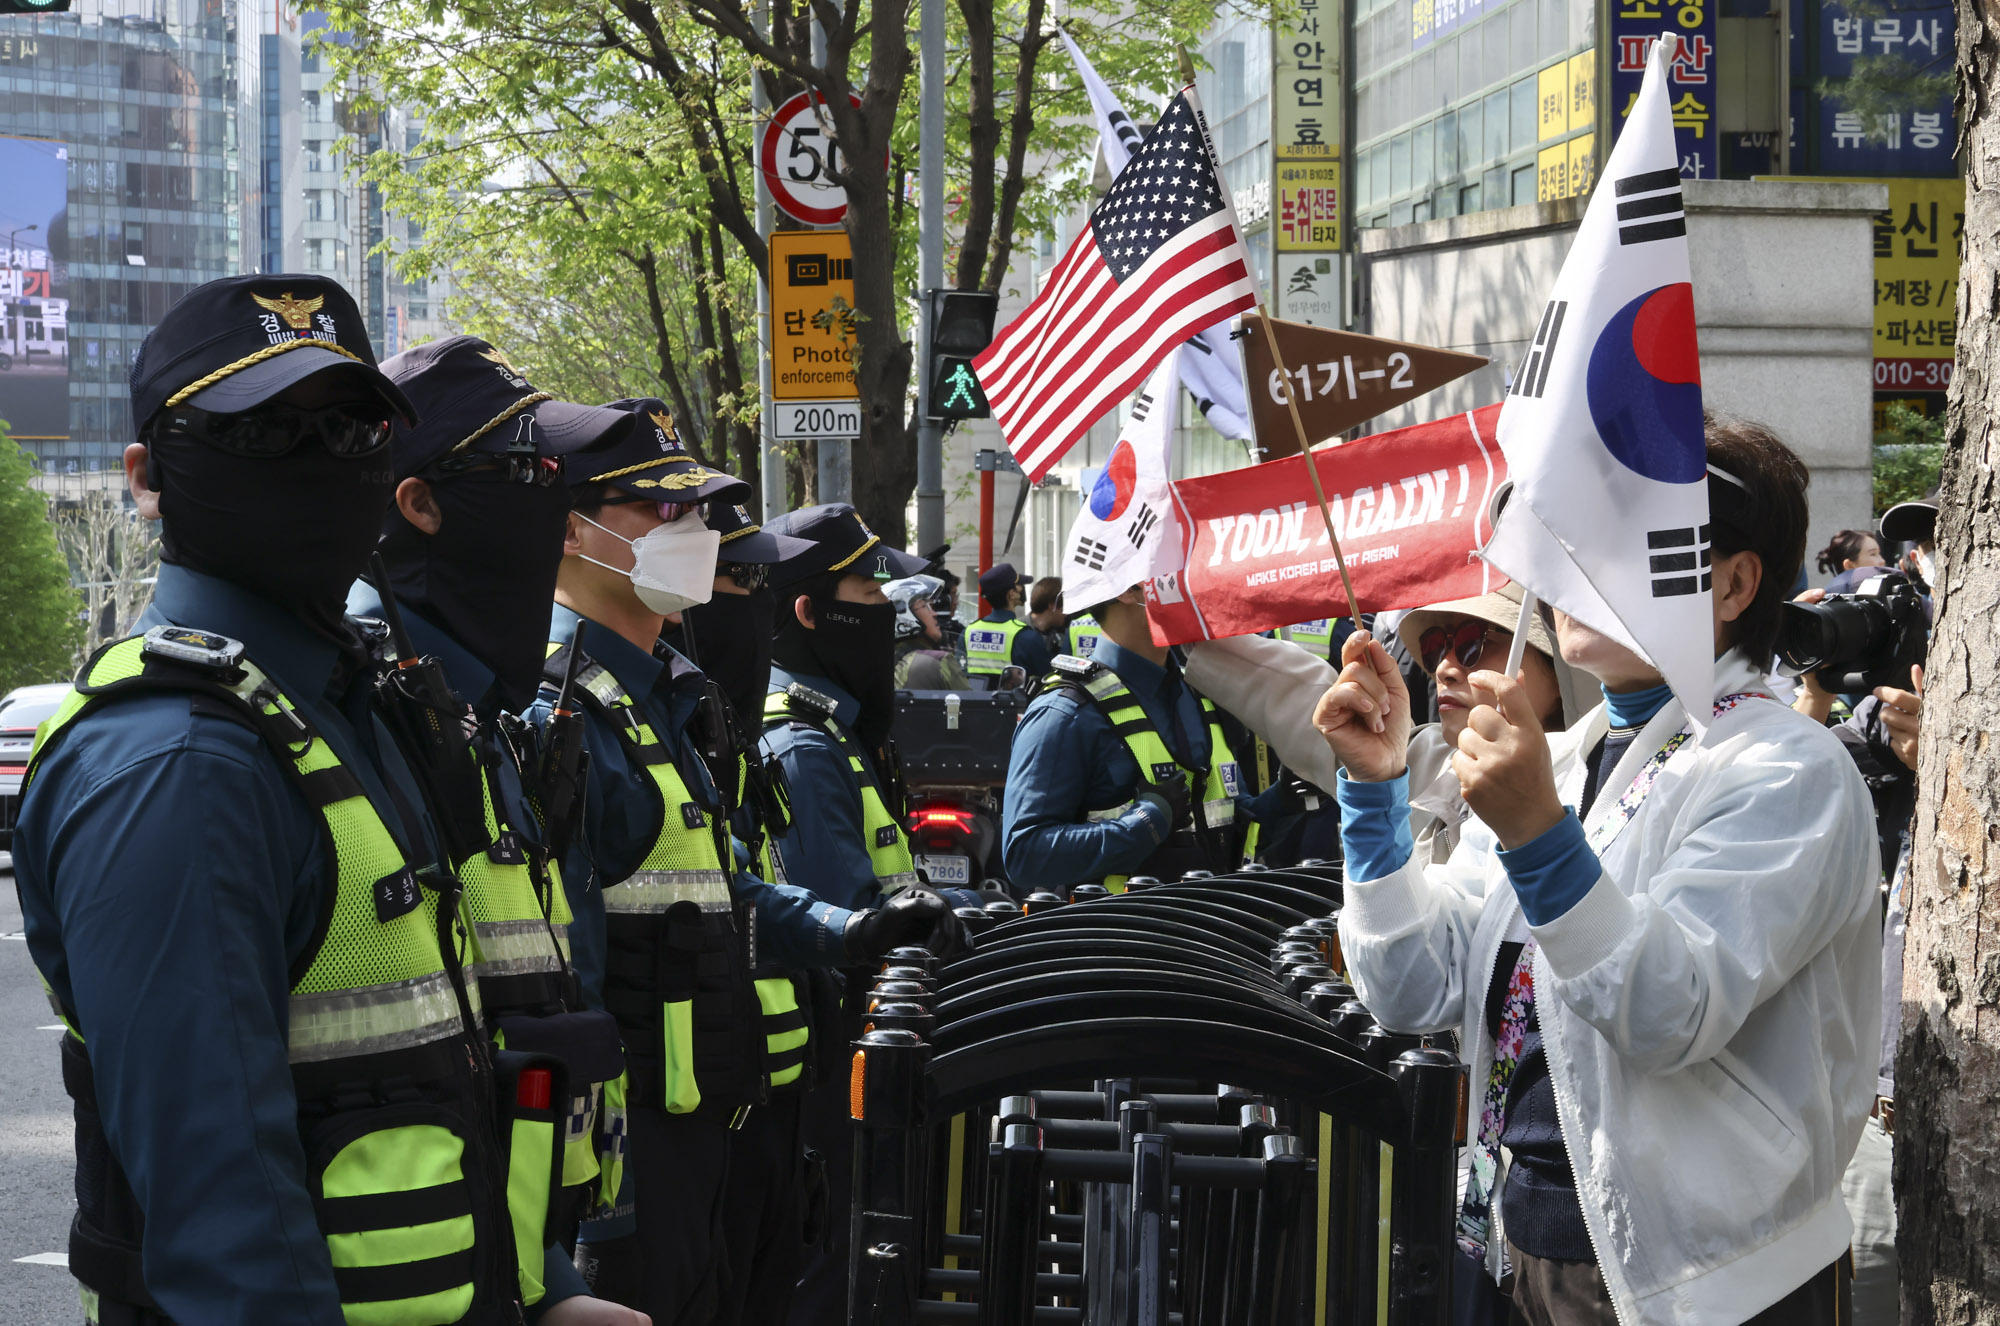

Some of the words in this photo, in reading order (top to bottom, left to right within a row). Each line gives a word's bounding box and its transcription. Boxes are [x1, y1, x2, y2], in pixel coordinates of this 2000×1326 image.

[1832, 18, 1943, 55] 법무사
[1619, 35, 1712, 84] 파산
[1293, 41, 1326, 145] 안연효
[1621, 92, 1710, 139] 속
[1312, 188, 1337, 220] 전문
[1312, 226, 1337, 243] 타자
[1268, 352, 1414, 405] 61기-2
[794, 408, 858, 432] 200m
[1207, 500, 1312, 568] YOON,
[1246, 568, 1278, 587] MAKE
[1278, 561, 1318, 580] KOREA
[1361, 544, 1400, 565] AGAIN
[971, 643, 1001, 651] POLICE
[930, 866, 965, 879] 7806
